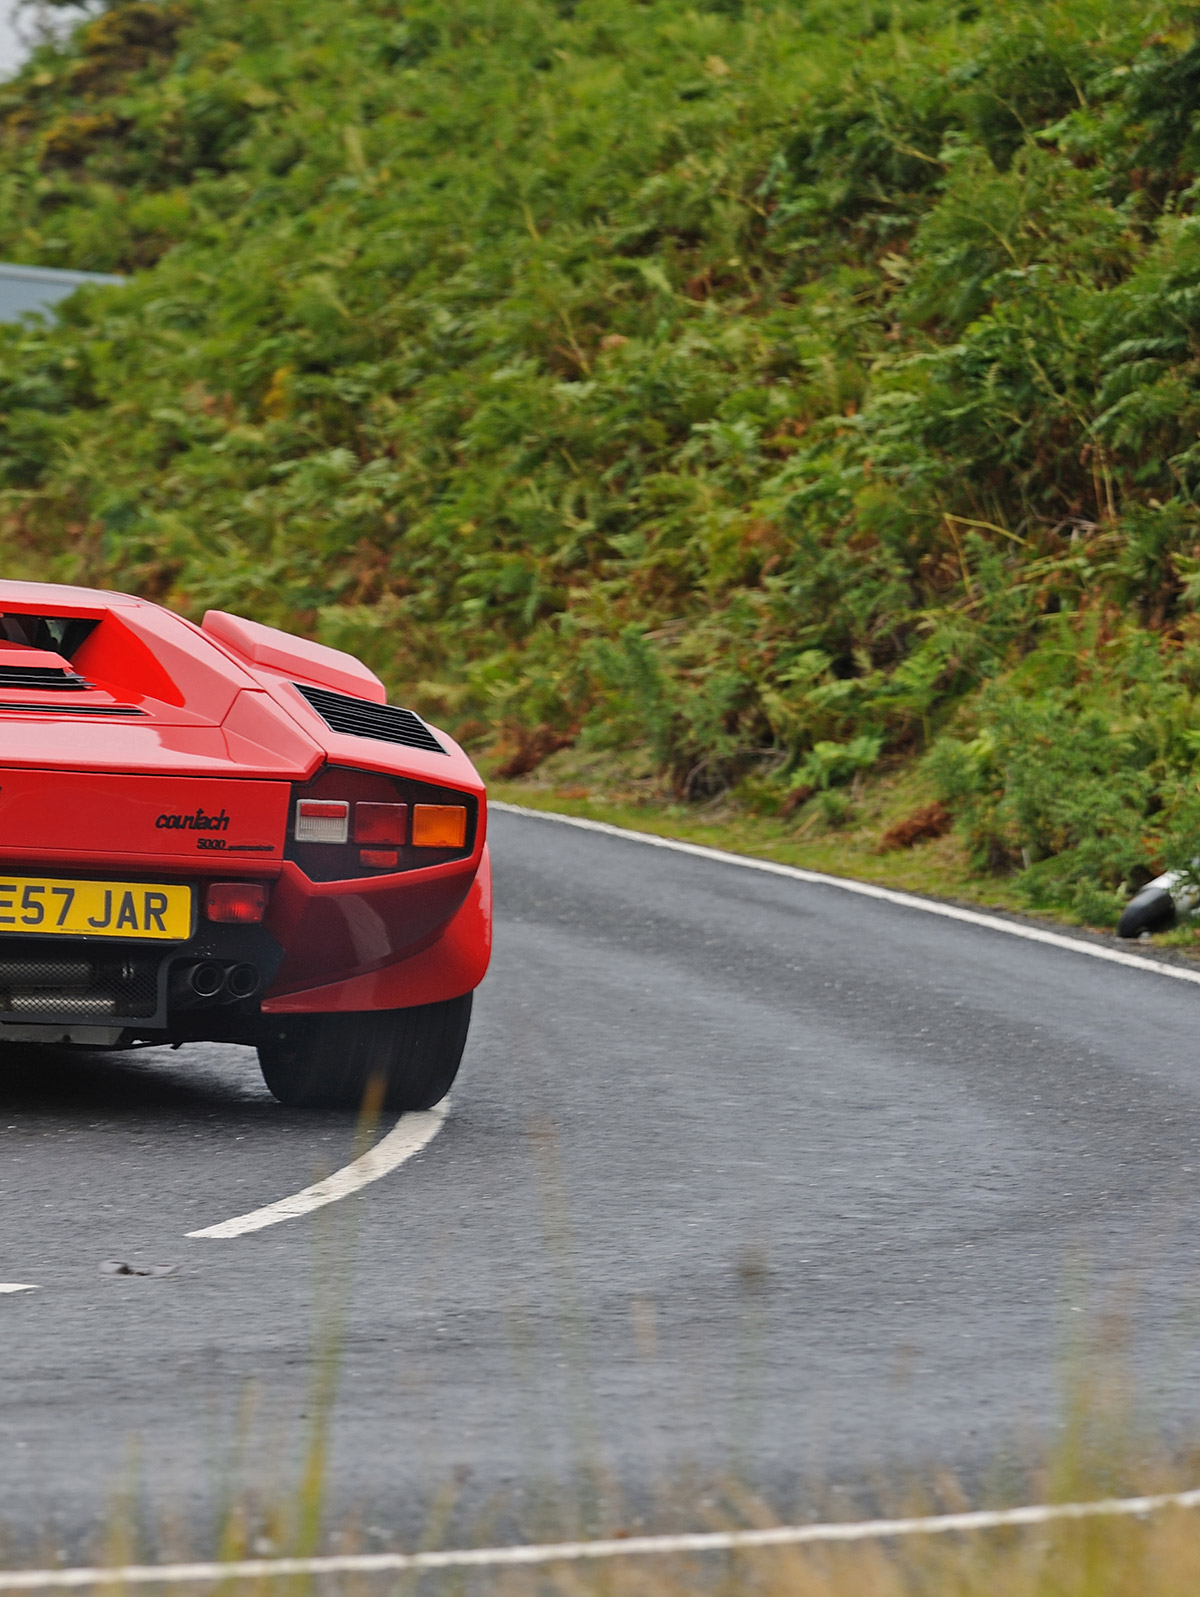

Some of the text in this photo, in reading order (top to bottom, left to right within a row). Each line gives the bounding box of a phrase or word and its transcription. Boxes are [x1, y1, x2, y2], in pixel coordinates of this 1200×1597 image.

[155, 807, 230, 831] countach
[196, 838, 226, 850] 5000
[87, 889, 168, 932] JAR
